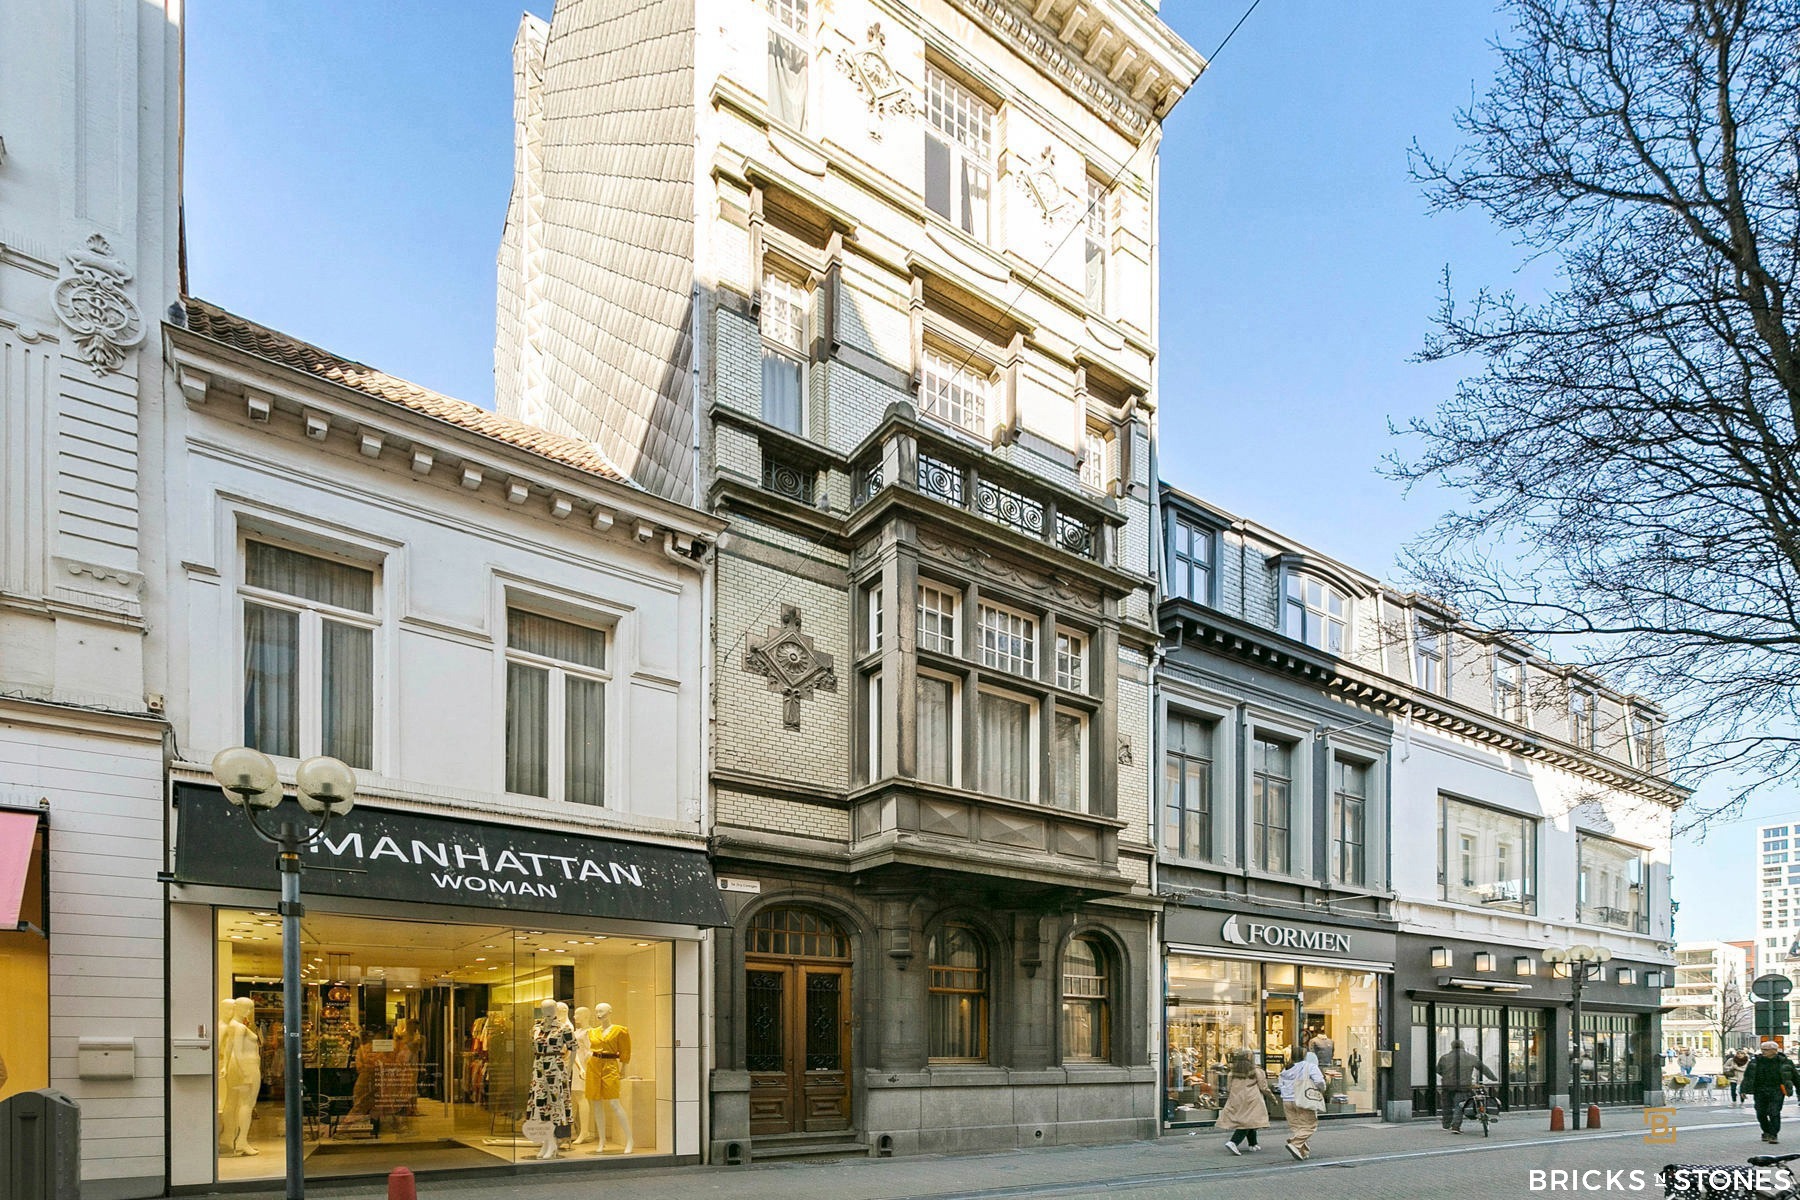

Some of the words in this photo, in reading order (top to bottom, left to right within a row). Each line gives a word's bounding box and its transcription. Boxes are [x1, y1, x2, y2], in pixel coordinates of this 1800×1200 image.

[309, 827, 643, 888] MANHATTAN
[431, 872, 558, 899] WOMAN
[1248, 922, 1352, 953] FORMEN
